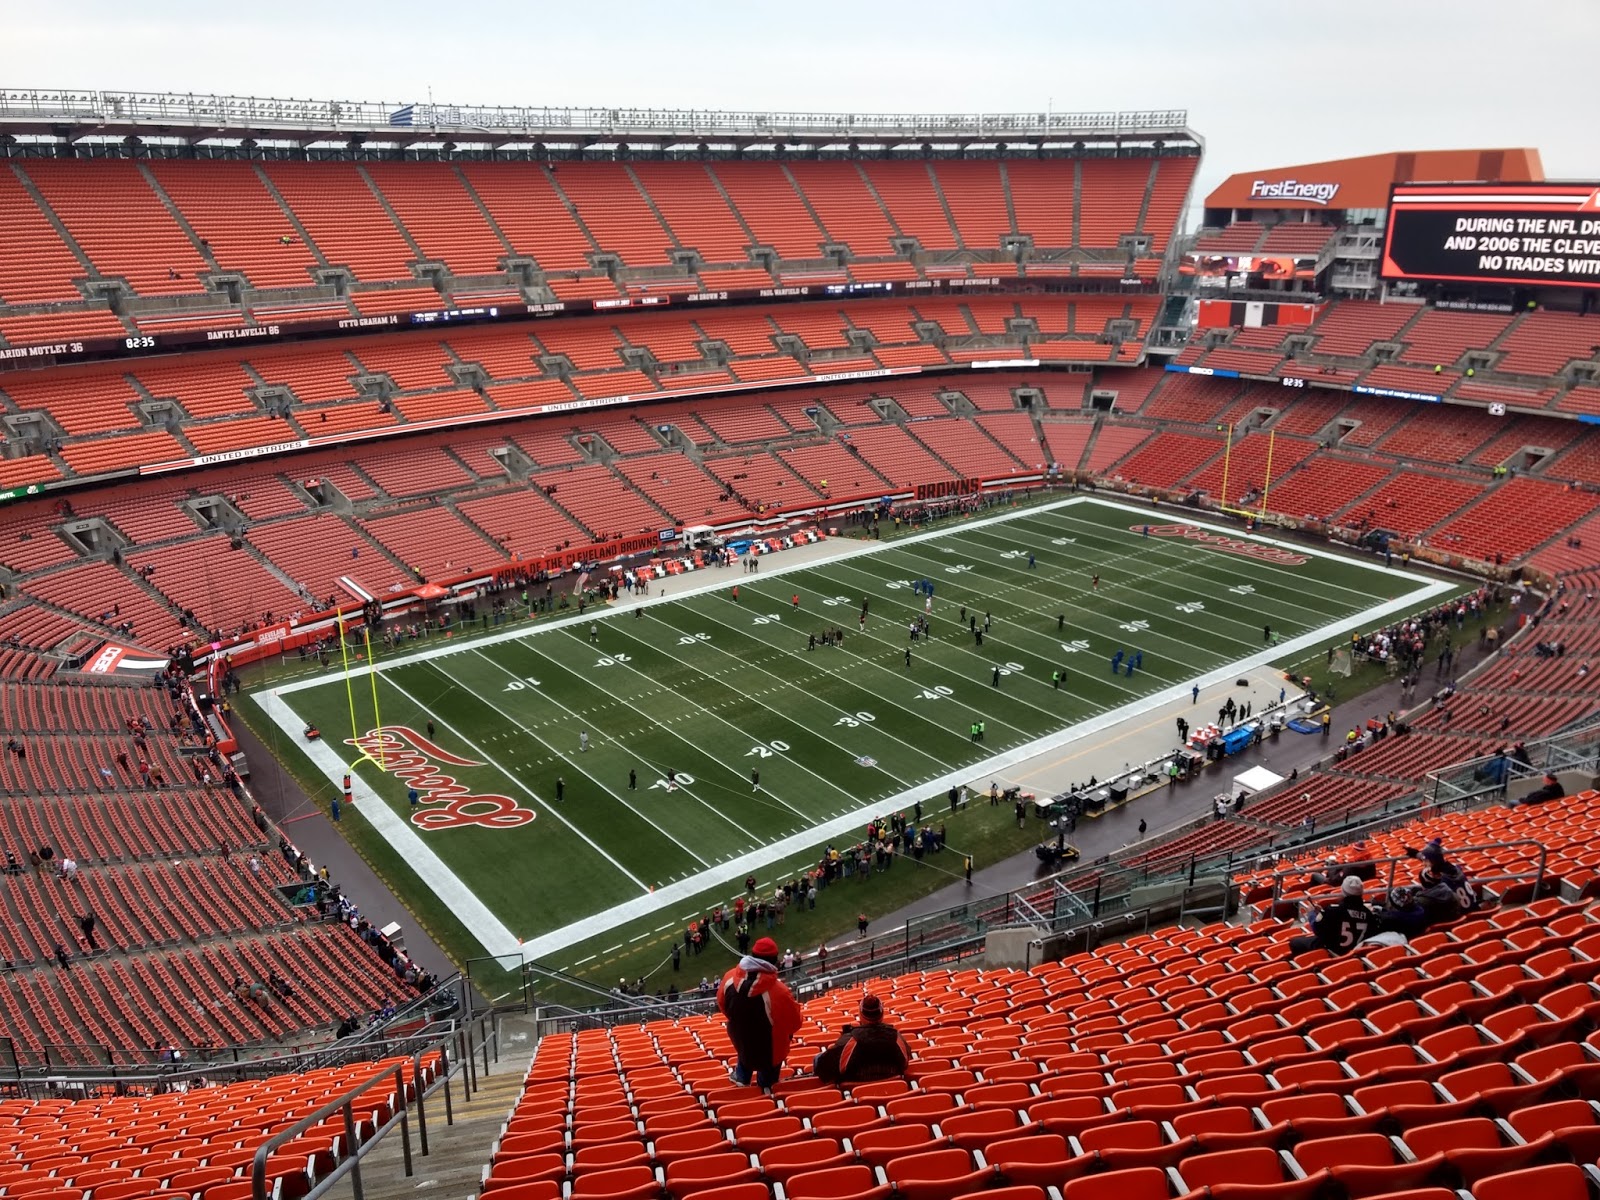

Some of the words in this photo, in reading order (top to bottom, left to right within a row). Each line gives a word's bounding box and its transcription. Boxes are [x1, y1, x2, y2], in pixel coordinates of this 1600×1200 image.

[420, 107, 498, 126] FirstEnergy
[501, 113, 571, 126] STADIUM
[1251, 180, 1339, 200] FirstEnergy
[1455, 218, 1514, 233] DURING
[1516, 218, 1546, 234] THE
[1547, 219, 1578, 235] NFL
[1443, 236, 1477, 250] AND
[1478, 237, 1519, 252] 2006
[1522, 238, 1552, 253] THE
[1553, 239, 1600, 255] CLEVE
[1479, 255, 1502, 270] NO
[1504, 256, 1565, 273] TRADES
[527, 304, 543, 312] PAUL
[543, 303, 564, 311] BROWN
[338, 319, 358, 328] OTTO
[359, 316, 388, 326] GRAHAM
[389, 315, 398, 324] 14
[207, 330, 235, 340] DANTE
[236, 327, 267, 338] LAVELLI
[268, 325, 279, 335] 86
[29, 344, 67, 356] MOTLEY
[70, 342, 83, 353] 36
[126, 336, 155, 349] 82:35
[547, 402, 578, 411] UNITED
[589, 397, 623, 406] STRIPES
[201, 452, 242, 464] UNITED
[256, 441, 302, 454] STRIPES
[918, 478, 979, 500] BROWNS
[1129, 524, 1313, 565] Browns
[529, 562, 542, 574] OF
[544, 557, 563, 571] THE
[566, 544, 617, 566] CLEVELAND
[620, 535, 658, 553] BROWNS
[1176, 602, 1204, 614] 20
[755, 613, 781, 626] 40
[1119, 621, 1149, 633] 30
[258, 627, 287, 641] CLEVELAND
[680, 632, 712, 646] 30
[1061, 640, 1090, 653] 40
[598, 653, 632, 668] 20
[508, 676, 542, 692] 10
[920, 685, 954, 701] 40
[839, 711, 876, 728] 30
[751, 740, 790, 759] 20
[343, 726, 536, 830] Browns
[1339, 921, 1368, 947] 57
